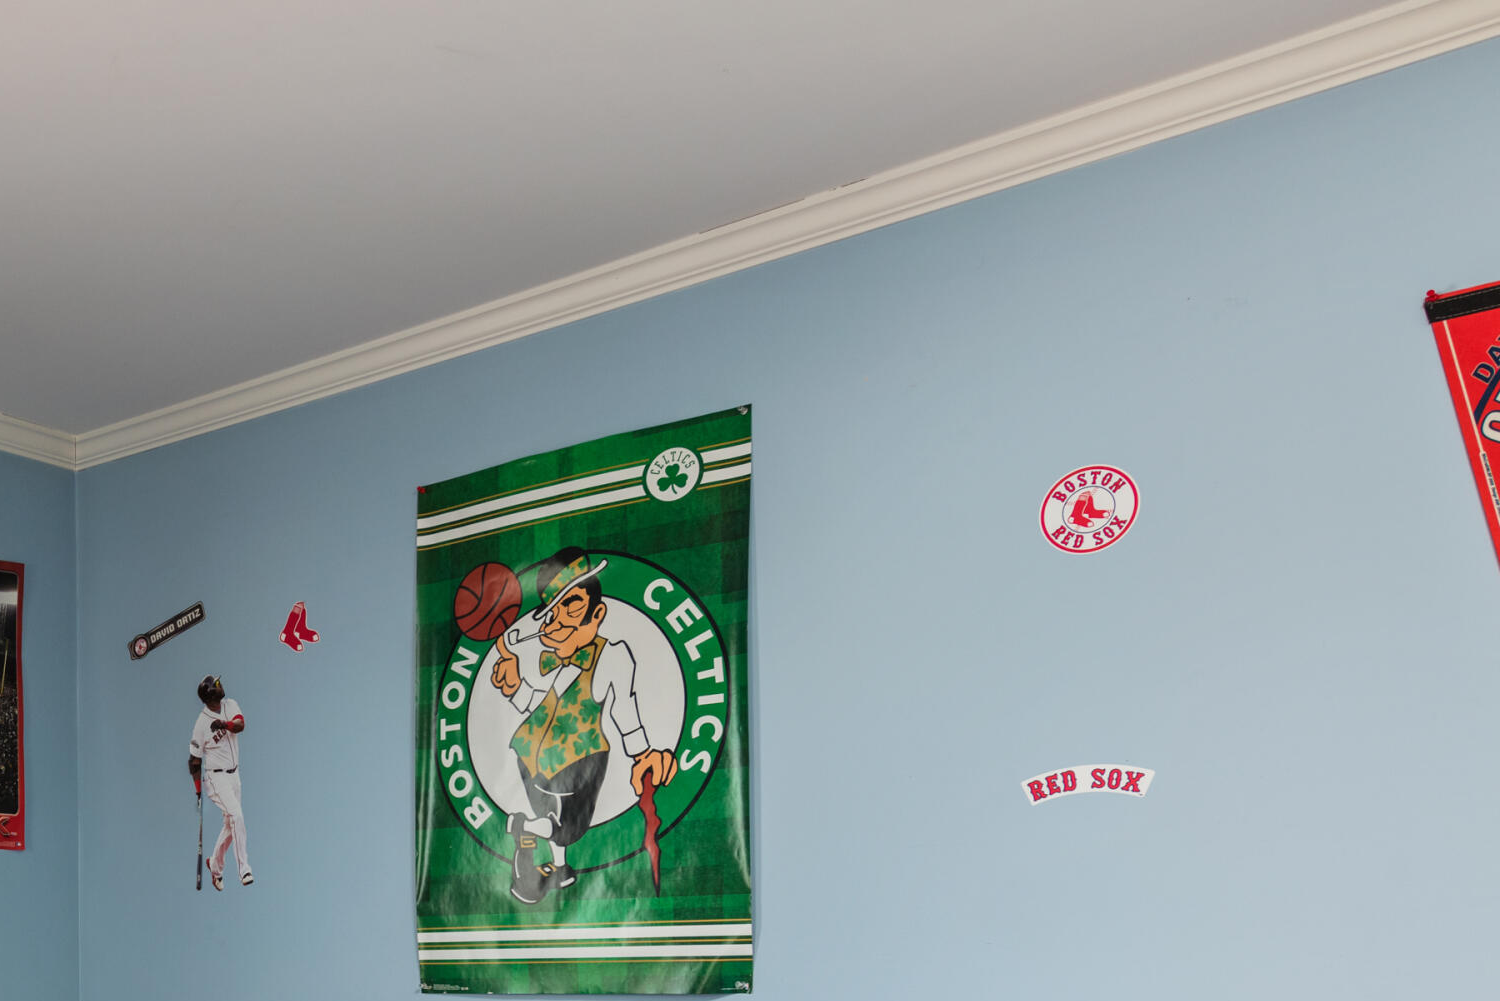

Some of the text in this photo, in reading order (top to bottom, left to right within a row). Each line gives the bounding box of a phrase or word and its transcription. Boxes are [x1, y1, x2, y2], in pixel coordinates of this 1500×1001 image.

[650, 450, 696, 475] CELTICS
[1052, 470, 1127, 503] BOSTON
[1051, 515, 1128, 549] RED SOX
[150, 607, 202, 645] DAVID ORTIZ
[643, 577, 726, 775] CELTICS
[438, 644, 495, 831] BOSTON
[1027, 768, 1146, 802] RED SOX
